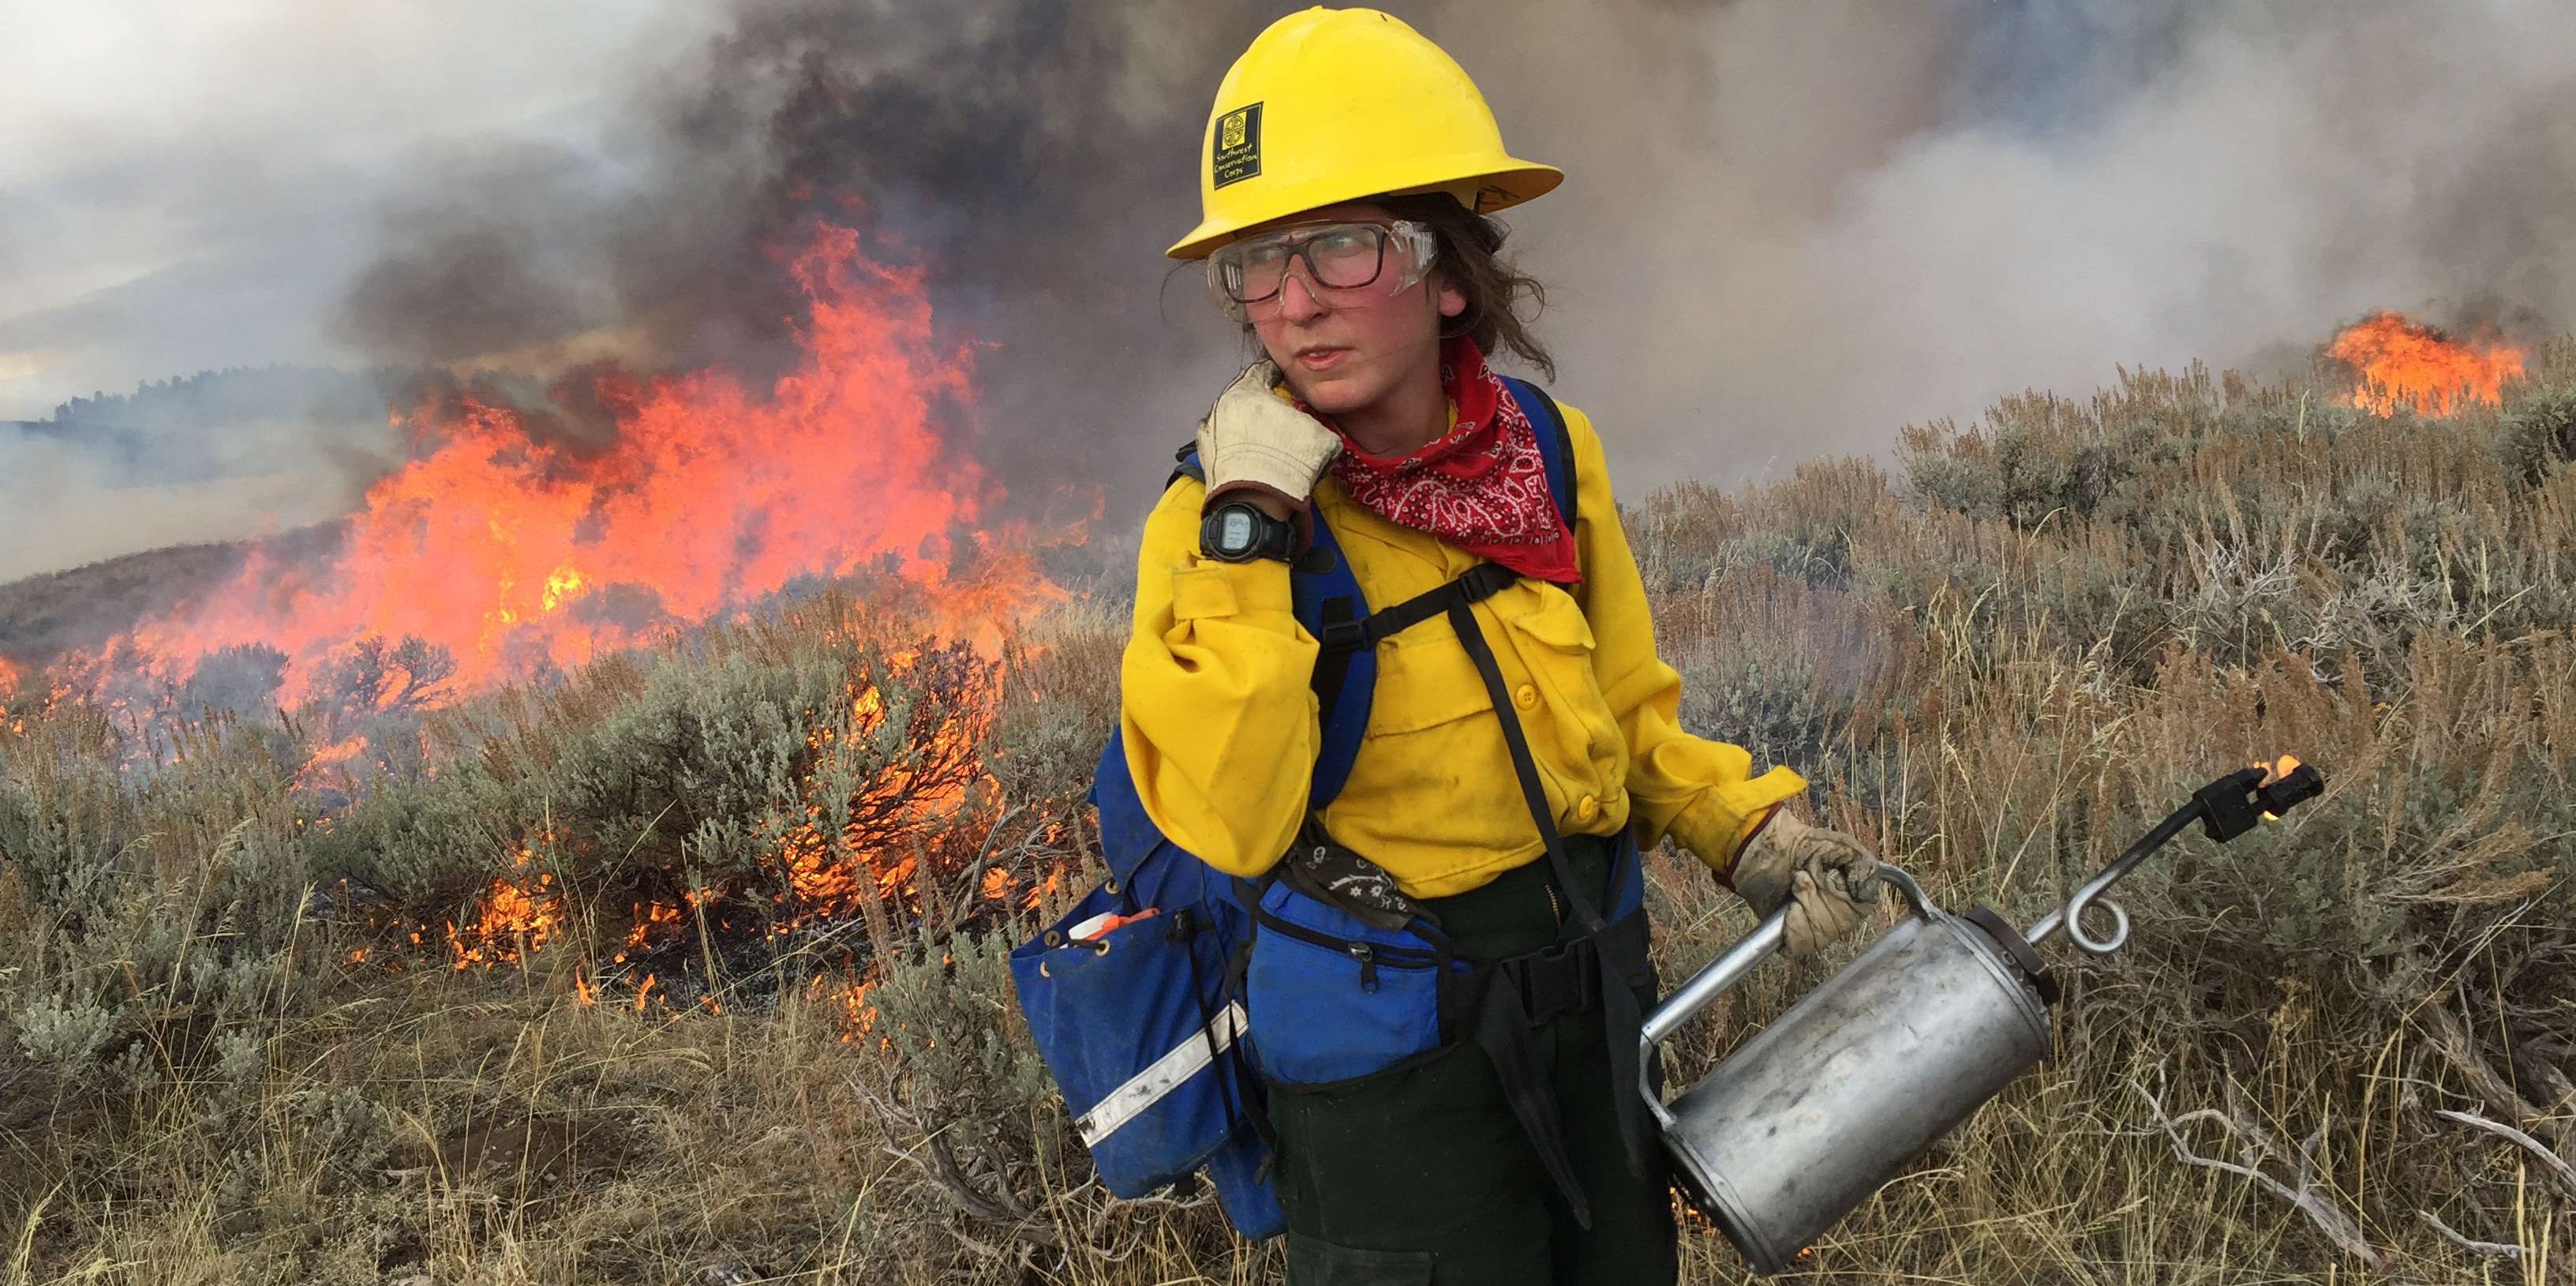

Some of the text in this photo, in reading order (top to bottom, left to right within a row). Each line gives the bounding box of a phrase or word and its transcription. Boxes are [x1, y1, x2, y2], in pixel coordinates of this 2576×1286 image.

[1216, 143, 1252, 162] Southwest
[1215, 155, 1257, 173] Conservation
[1225, 167, 1243, 178] Corps
